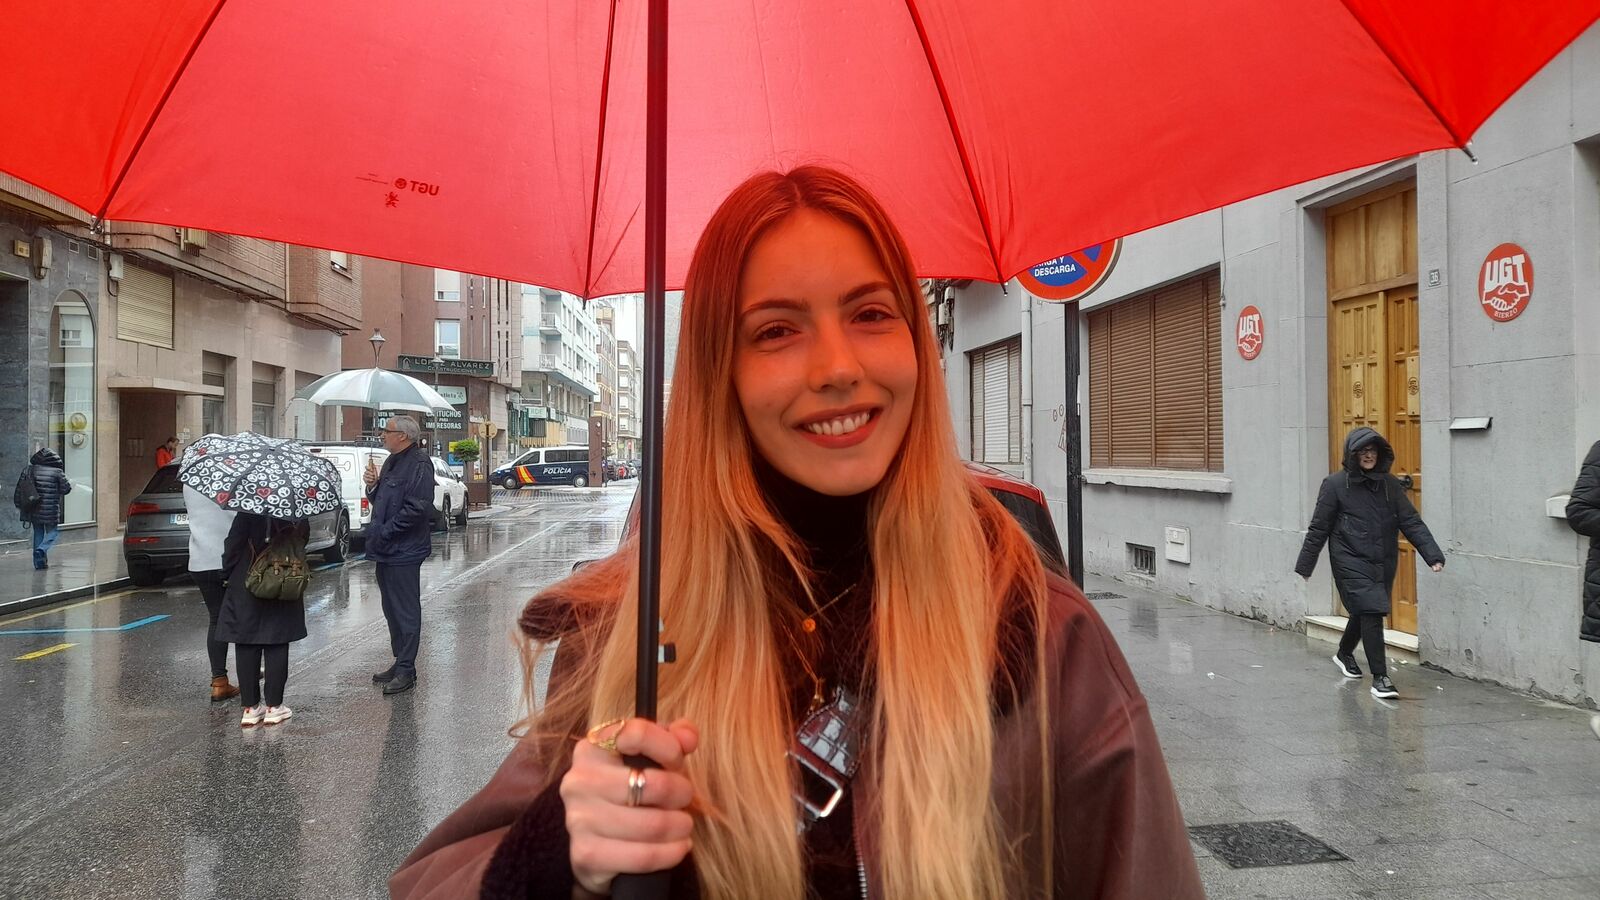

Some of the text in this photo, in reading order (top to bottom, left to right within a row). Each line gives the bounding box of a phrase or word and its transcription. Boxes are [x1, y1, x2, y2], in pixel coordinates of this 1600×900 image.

[1059, 256, 1065, 264] Y
[1034, 264, 1076, 277] DESCARGA
[1484, 254, 1526, 293] UGT
[1494, 308, 1518, 319] BIERZO
[1239, 313, 1260, 338] UGT
[450, 361, 490, 370] ALVAREZ
[543, 466, 572, 475] POLICIA
[176, 513, 189, 522] 09
